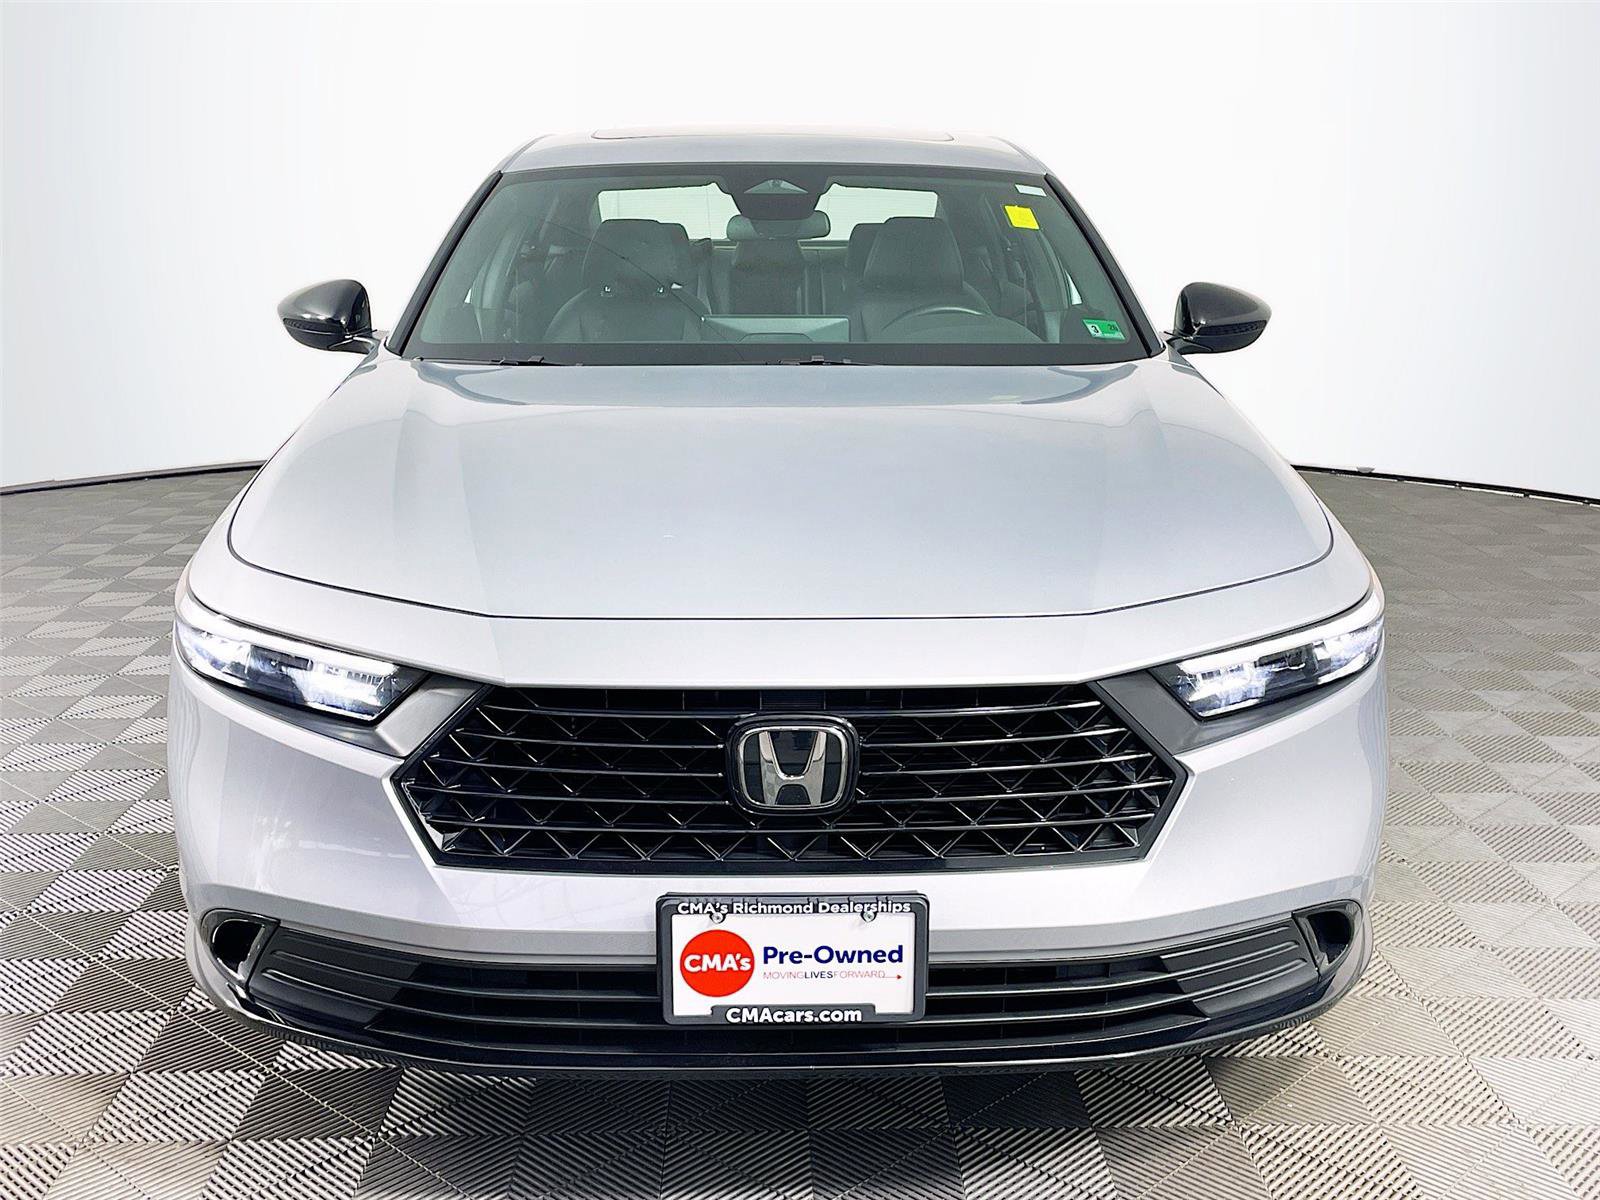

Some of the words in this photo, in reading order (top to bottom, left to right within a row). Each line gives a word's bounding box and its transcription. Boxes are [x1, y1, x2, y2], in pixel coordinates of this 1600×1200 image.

[677, 902, 728, 914] CMA's
[733, 902, 813, 914] Richmond
[818, 901, 911, 914] Dealerships
[763, 944, 904, 964] Pre-Owned
[684, 954, 751, 972] CMA's
[726, 1008, 862, 1023] CMAcars.com
